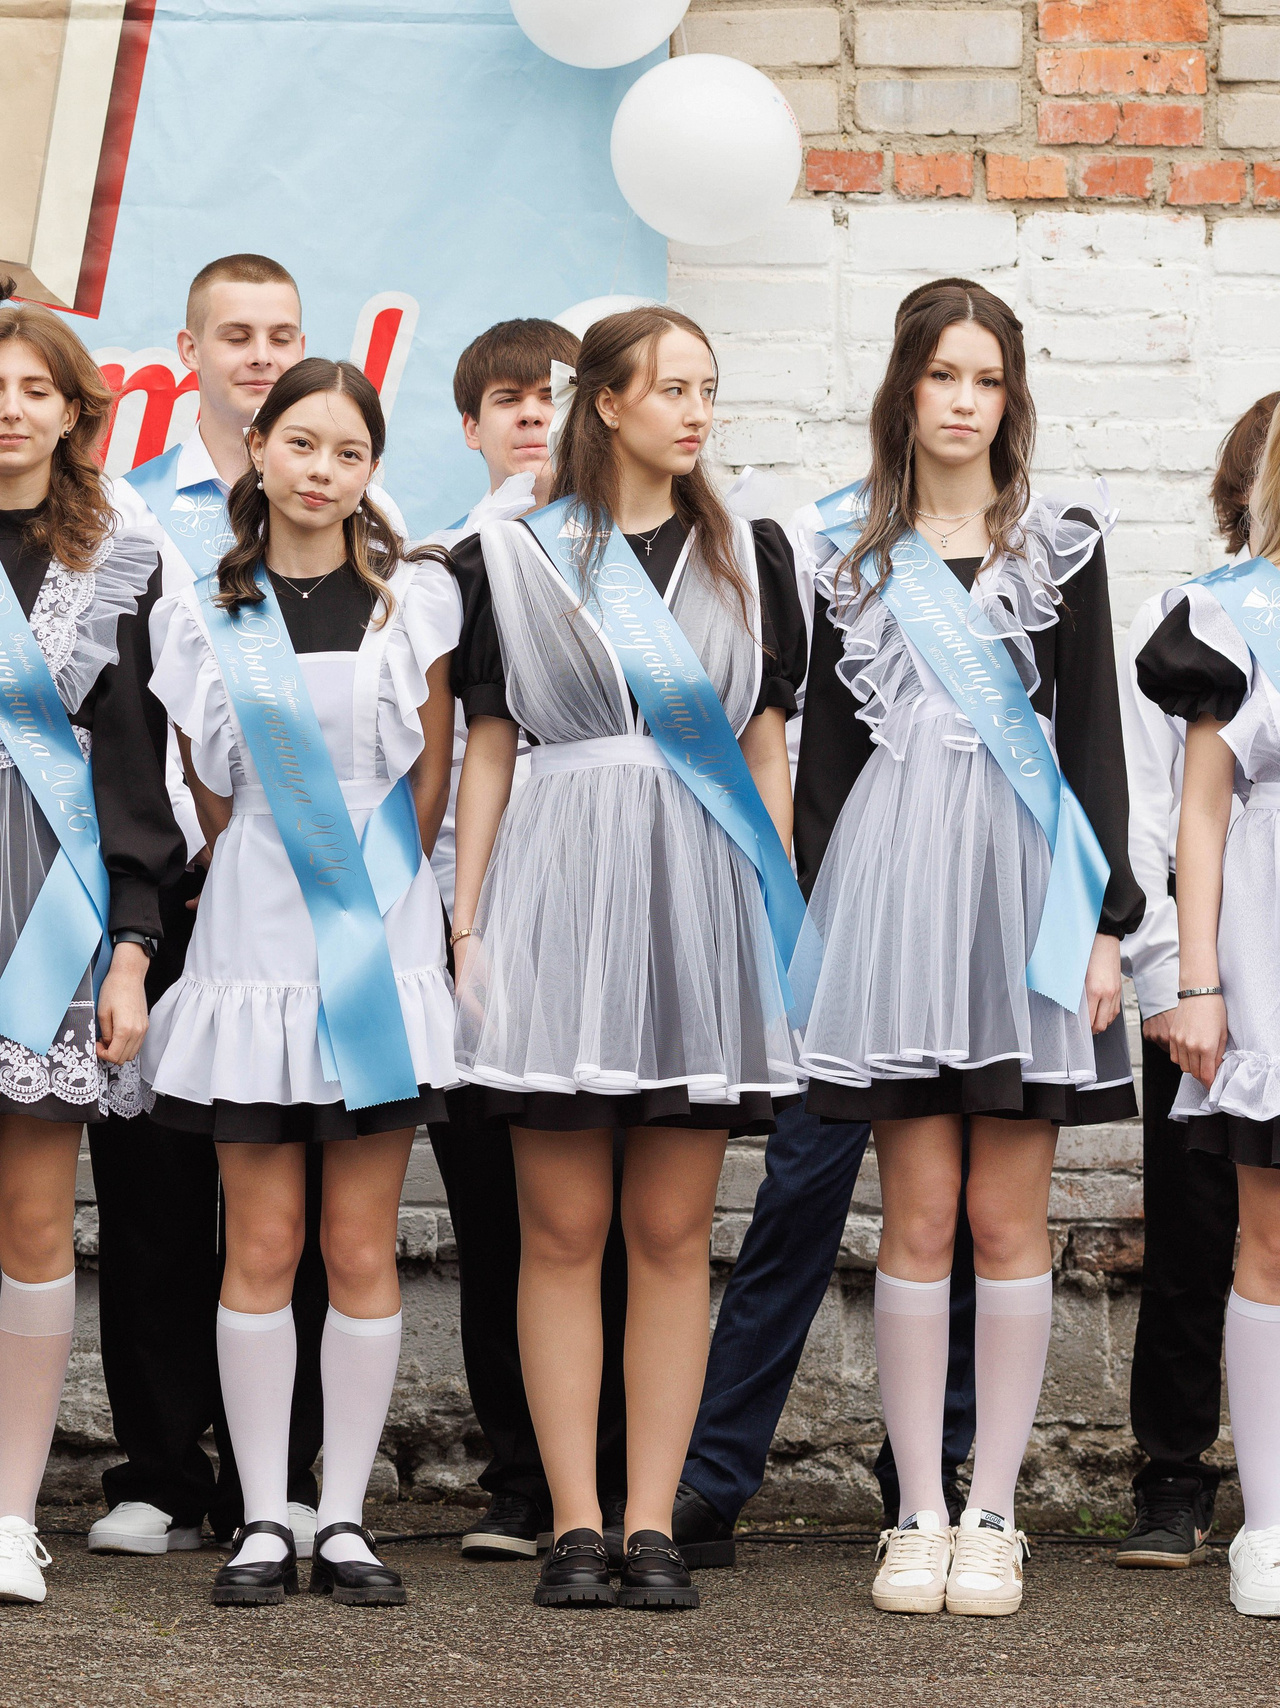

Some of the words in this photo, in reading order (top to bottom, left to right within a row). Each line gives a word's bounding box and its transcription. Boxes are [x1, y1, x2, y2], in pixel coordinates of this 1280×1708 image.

[230, 611, 312, 804] Выпускница
[296, 813, 357, 886] 2026
[590, 563, 700, 744] Выпускница
[888, 541, 1003, 707] Выпускница
[991, 708, 1042, 779] 2026
[38, 764, 97, 832] 2026
